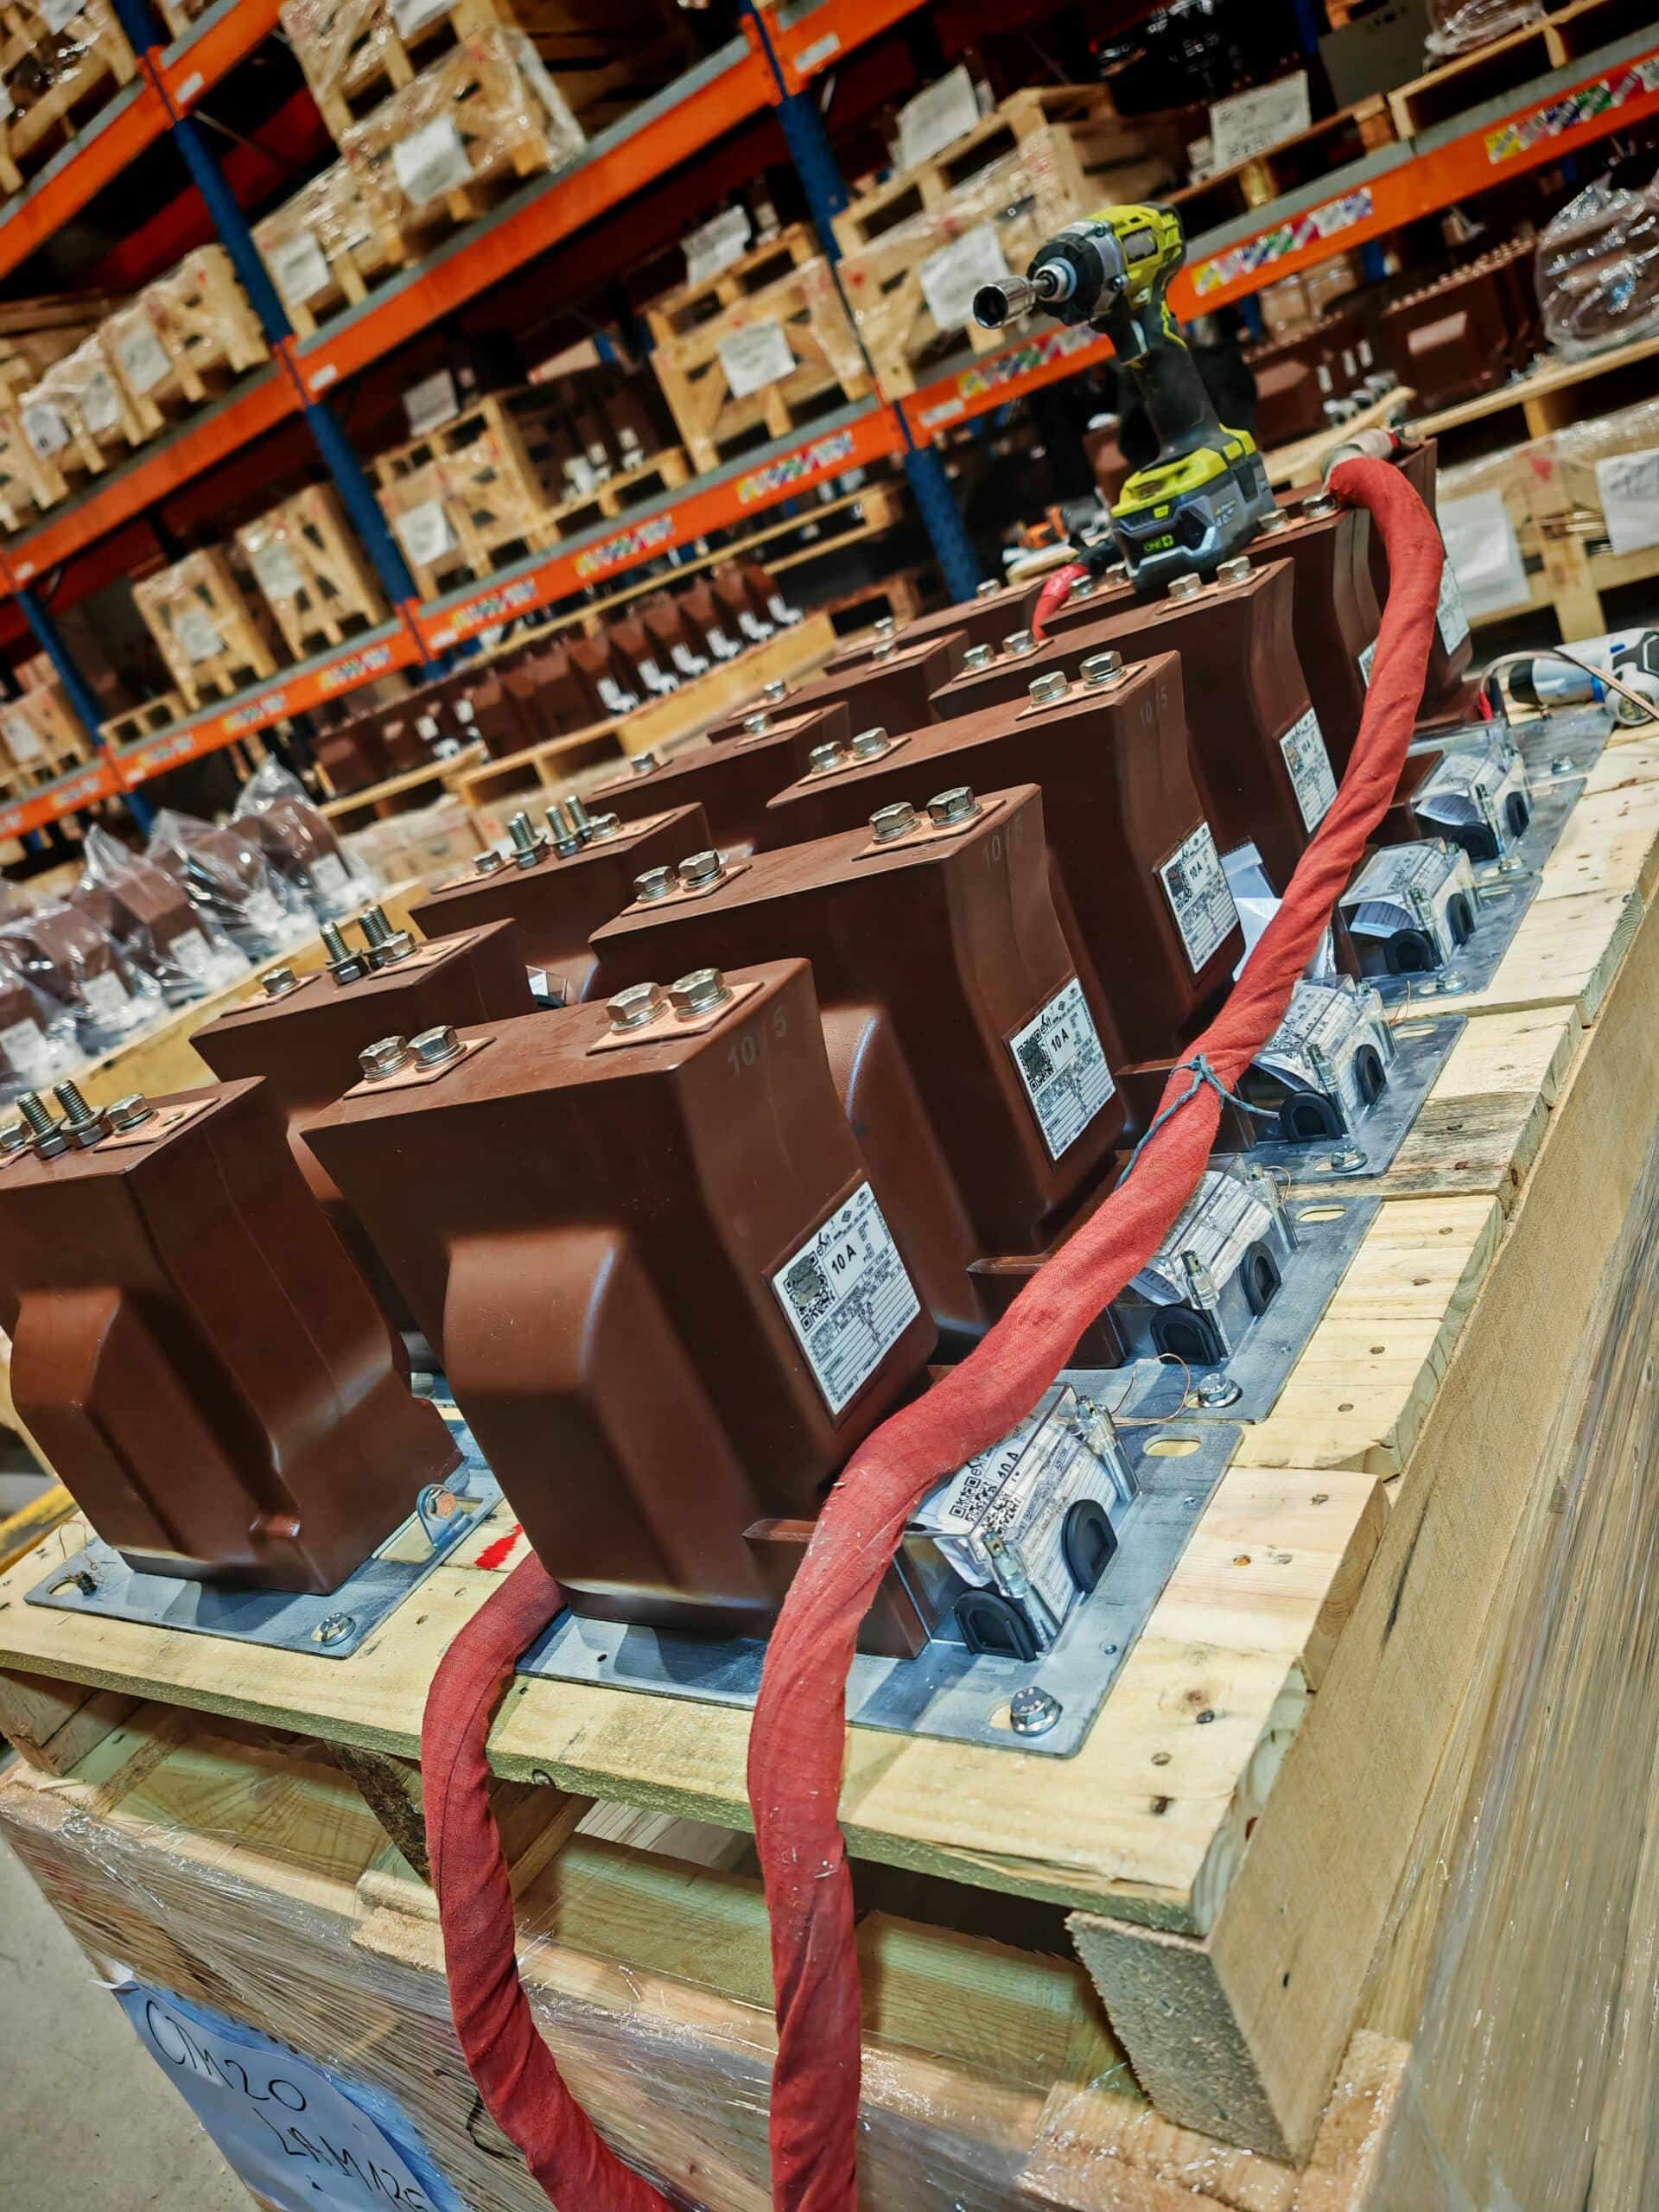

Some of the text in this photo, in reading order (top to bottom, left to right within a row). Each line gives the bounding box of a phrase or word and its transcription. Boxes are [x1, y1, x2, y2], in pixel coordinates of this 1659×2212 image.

[1189, 863, 1203, 880] 10 A
[1051, 1028, 1070, 1052] 10 A
[831, 1243, 857, 1275] 10 A
